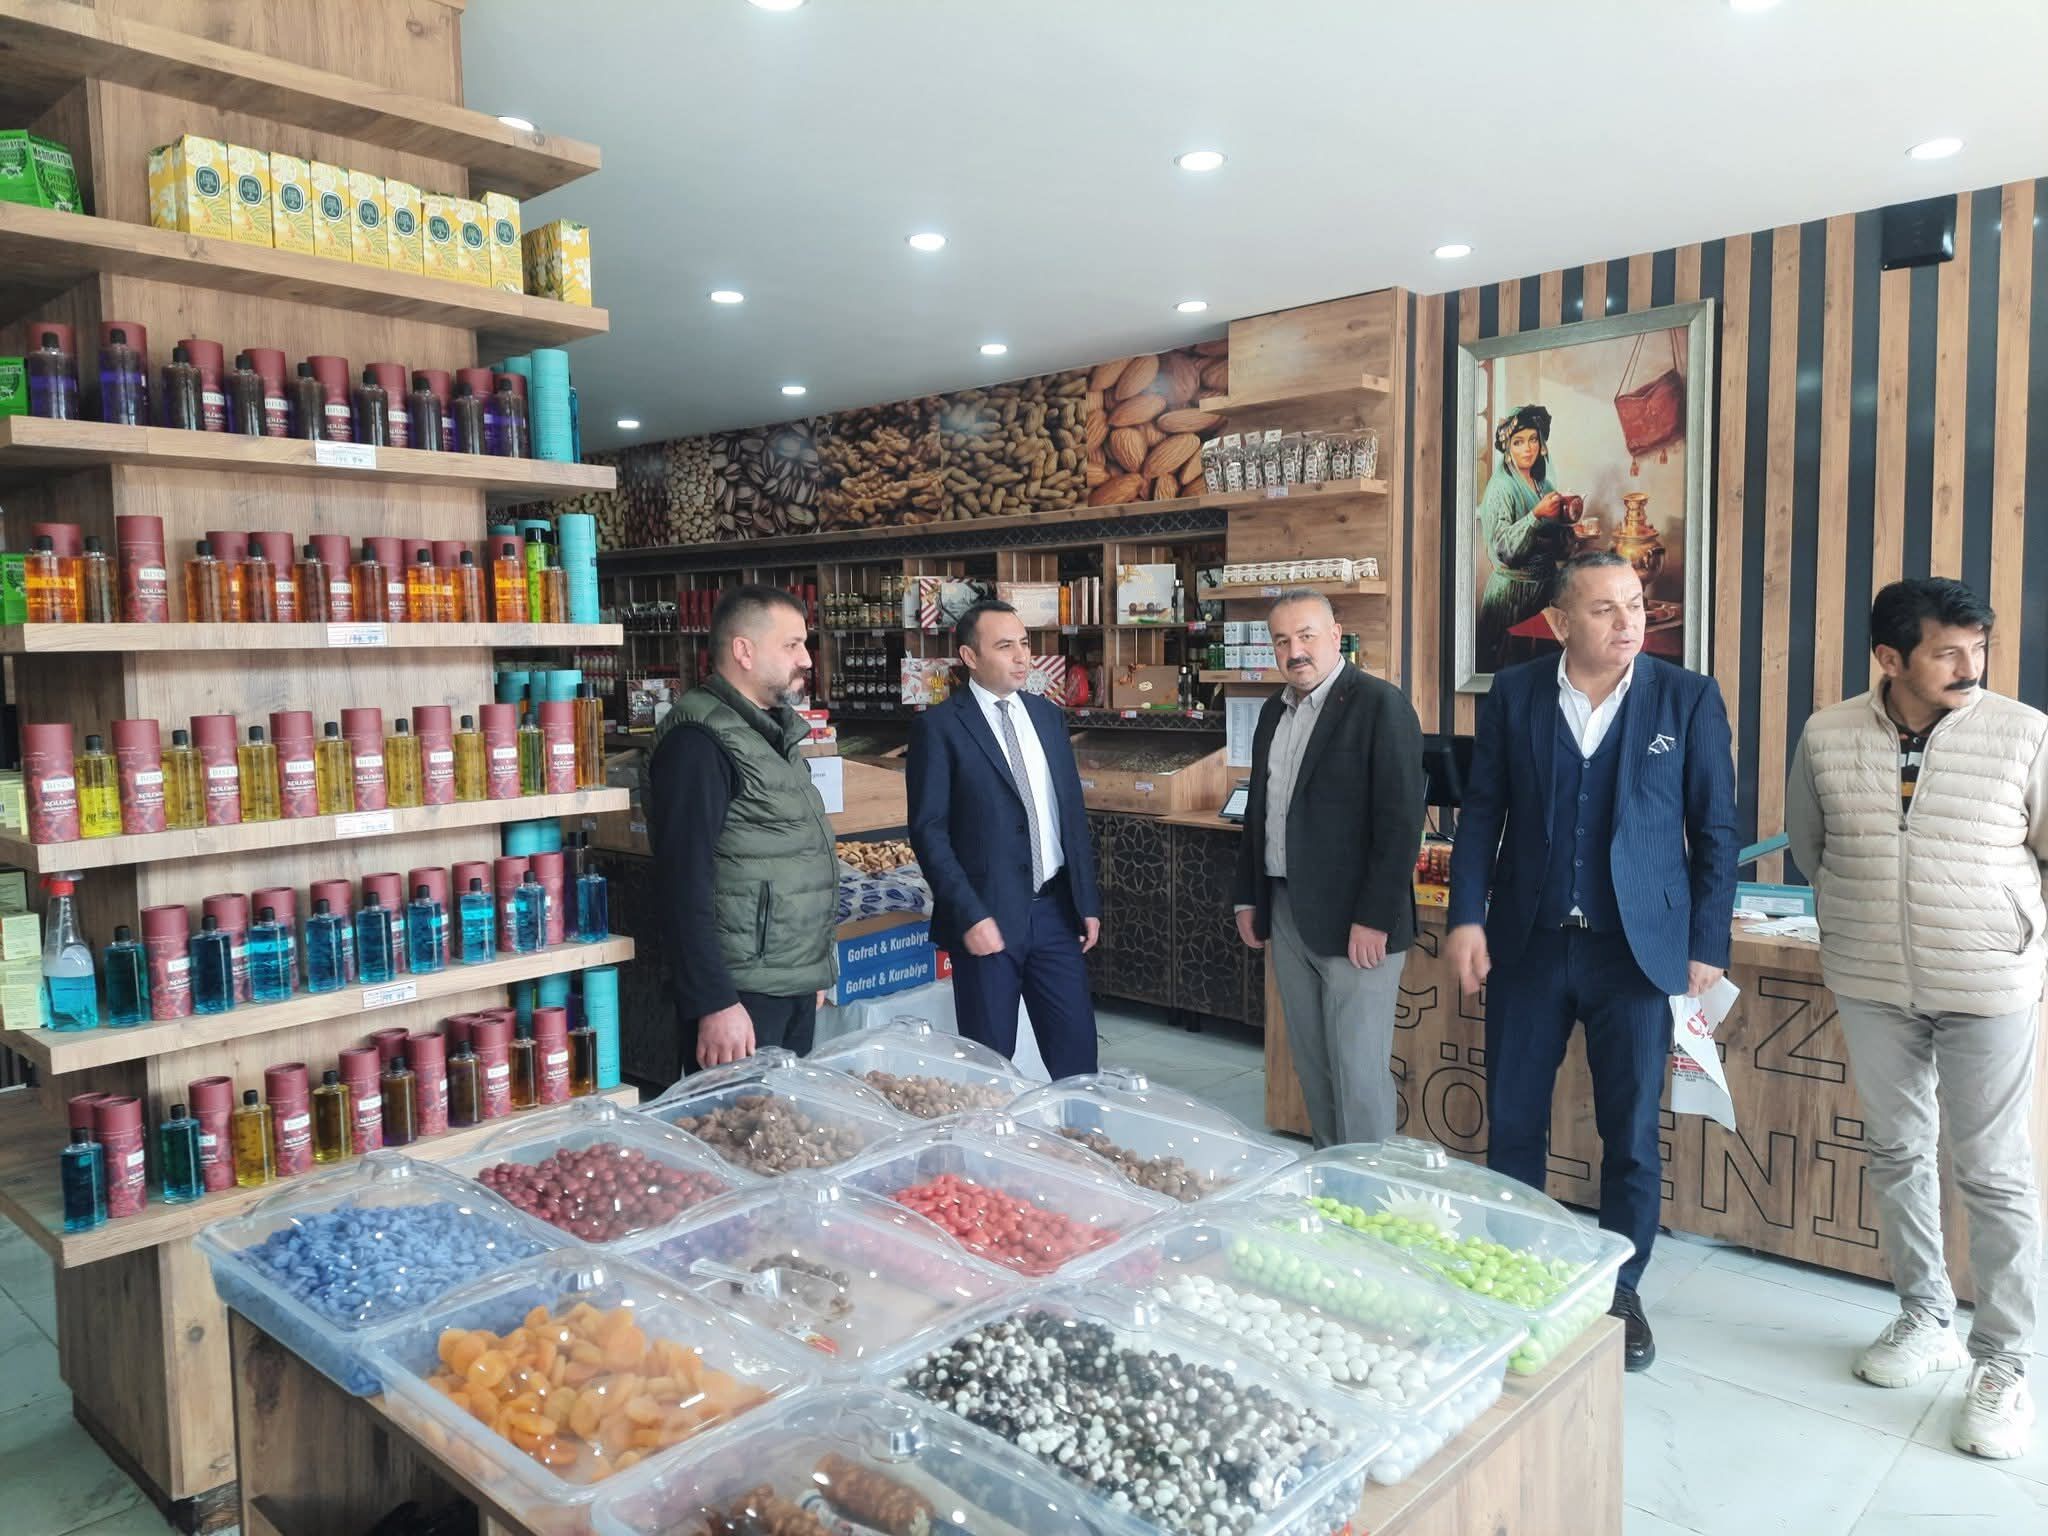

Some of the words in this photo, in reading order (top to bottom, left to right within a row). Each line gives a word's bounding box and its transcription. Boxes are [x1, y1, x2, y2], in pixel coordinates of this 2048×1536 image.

[848, 945, 878, 963] Gofret
[880, 941, 888, 953] &
[890, 931, 929, 951] Kurabiye
[846, 978, 876, 994] Gofret
[878, 972, 886, 985] &
[888, 963, 928, 983] Kurabiye
